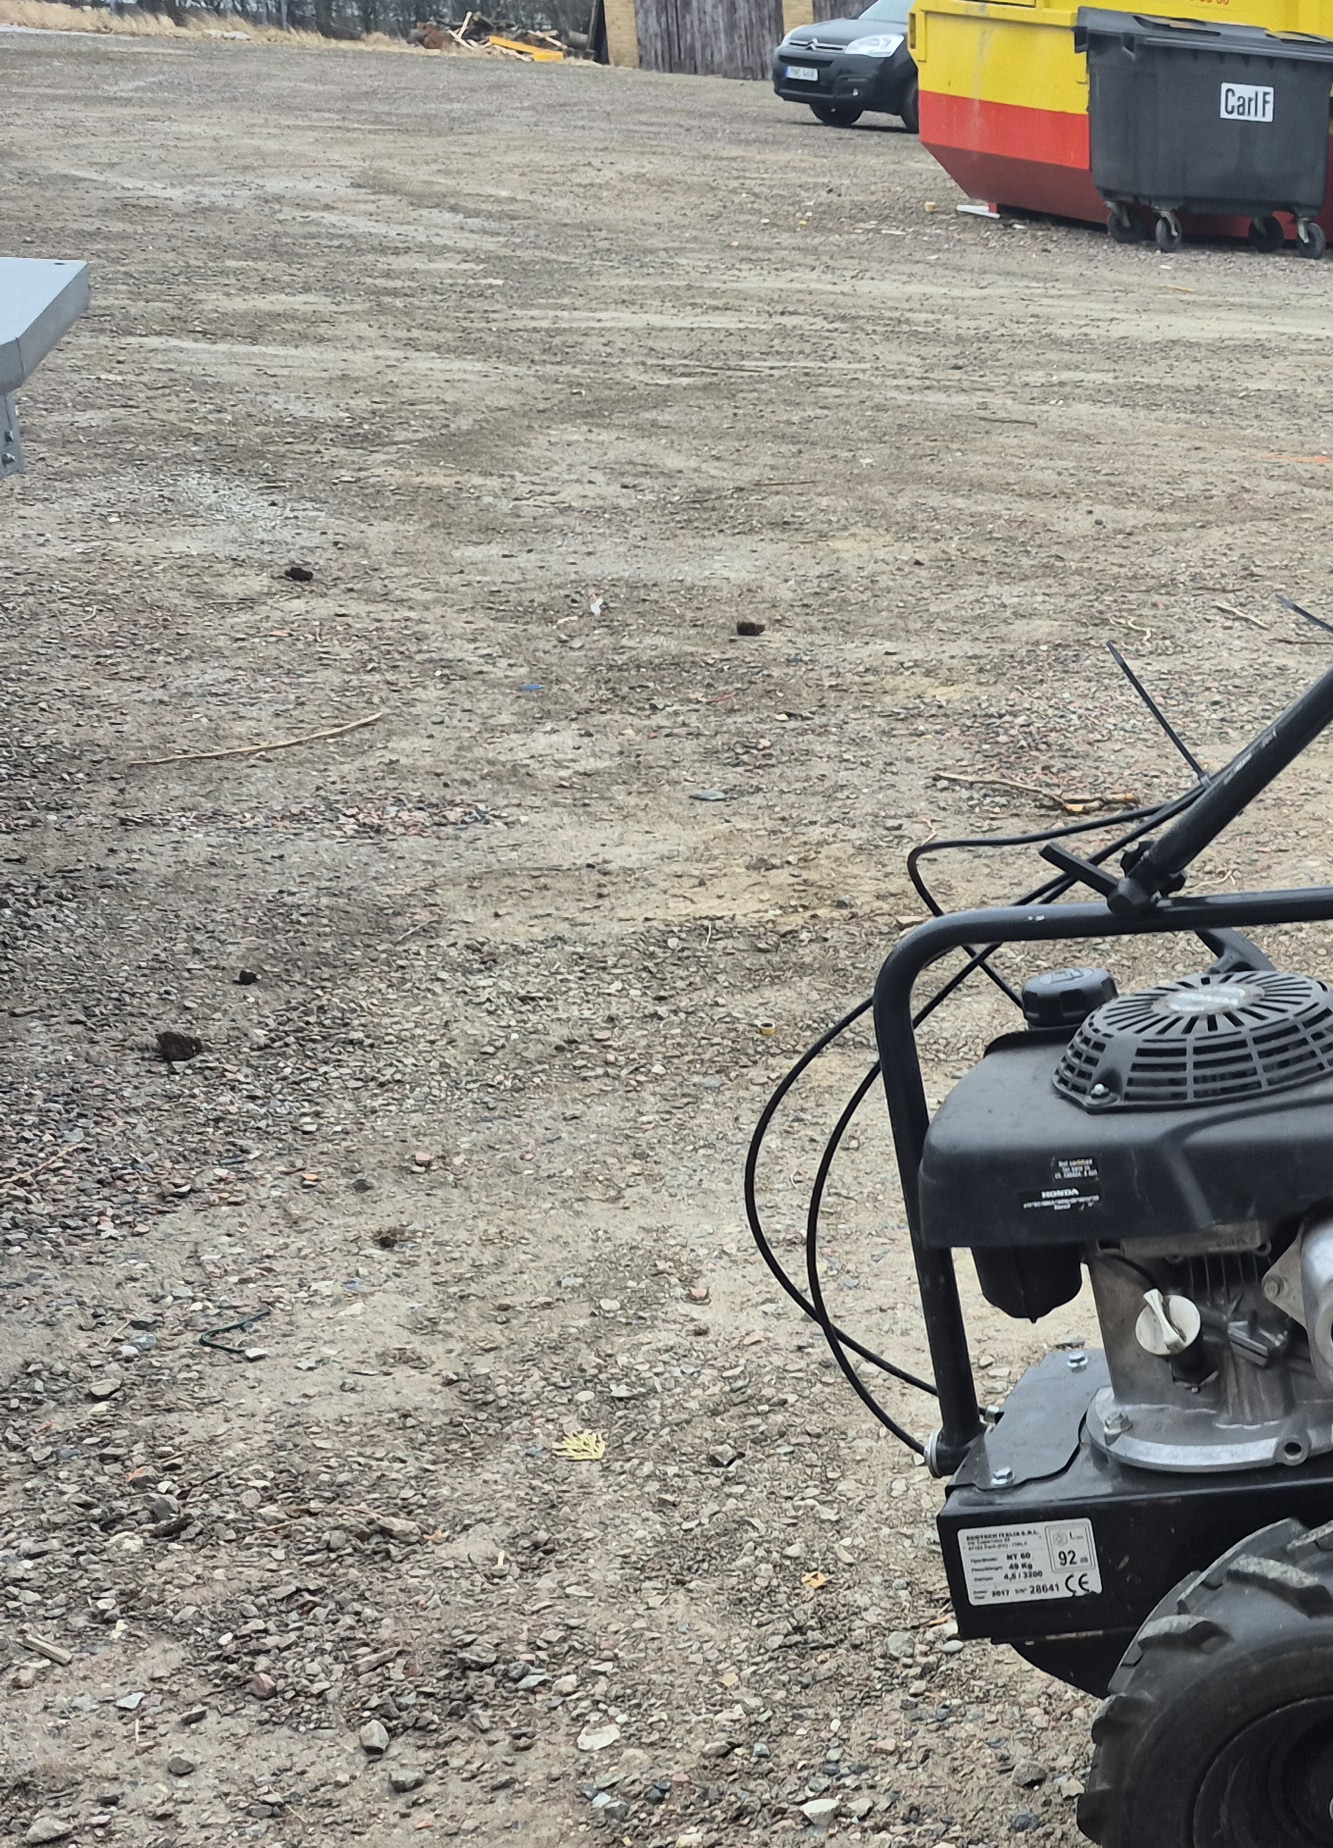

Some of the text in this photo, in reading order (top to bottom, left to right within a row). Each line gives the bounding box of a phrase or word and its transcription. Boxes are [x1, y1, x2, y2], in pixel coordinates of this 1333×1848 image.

[1225, 88, 1271, 118] Carl F
[1041, 1188, 1079, 1199] HONDA
[1058, 1550, 1077, 1566] 92
